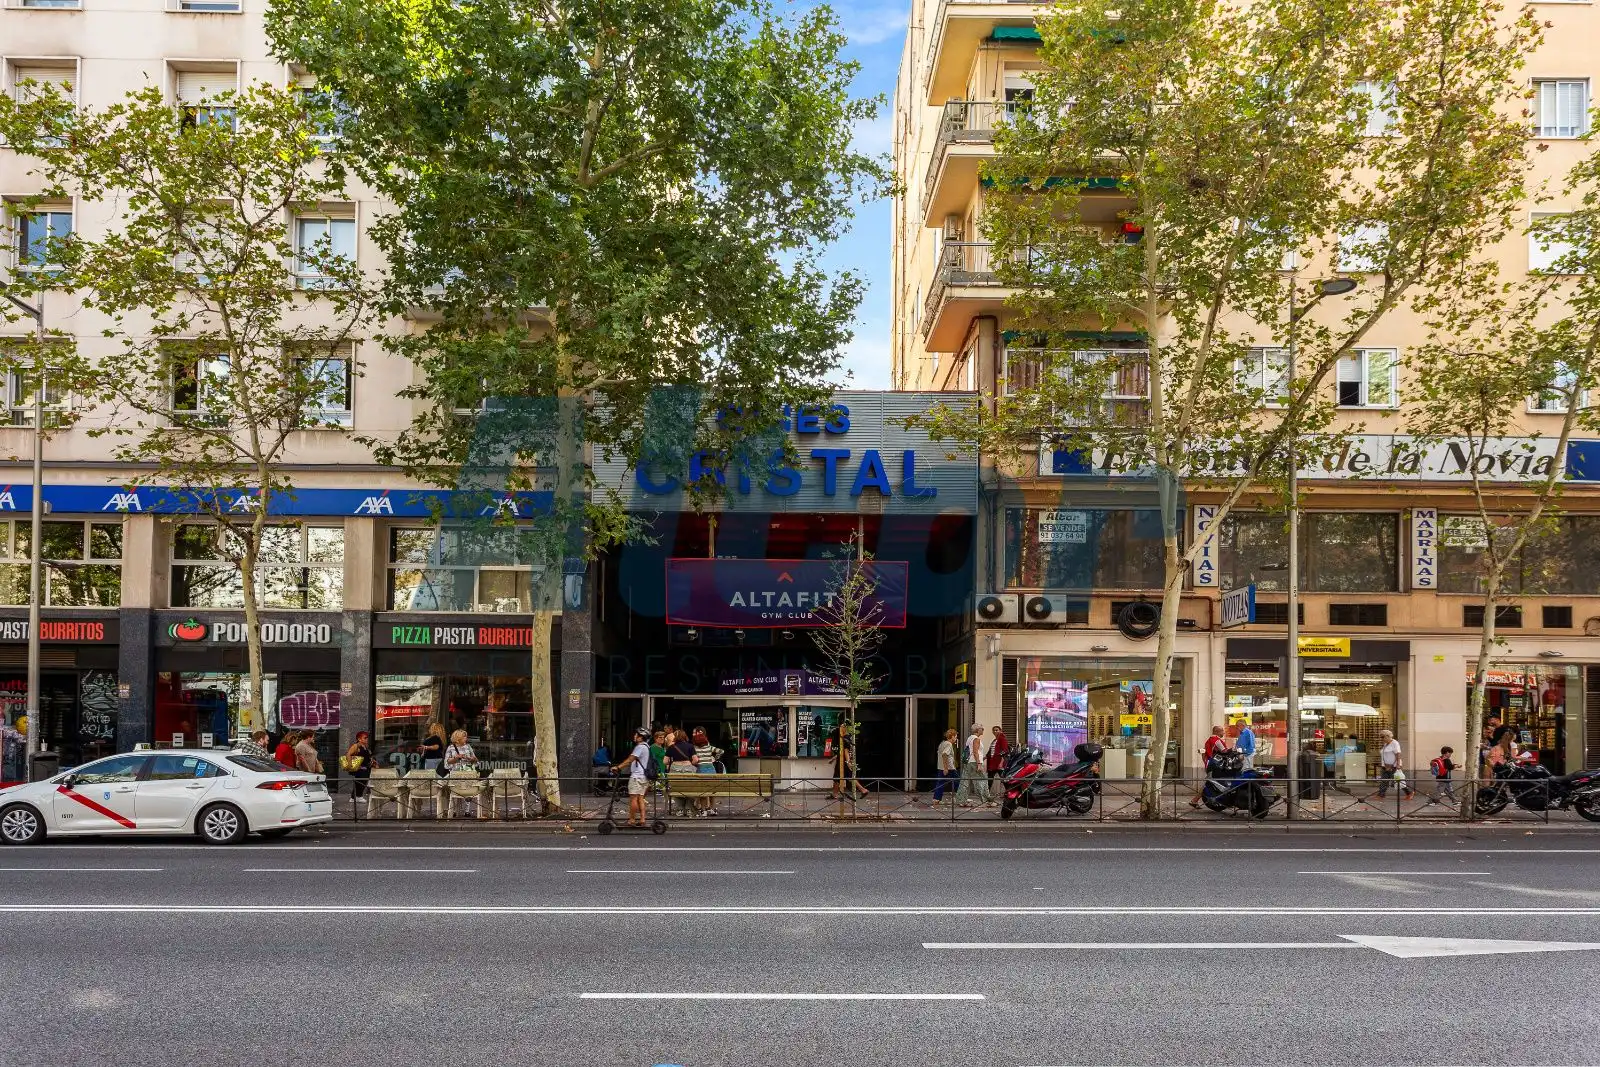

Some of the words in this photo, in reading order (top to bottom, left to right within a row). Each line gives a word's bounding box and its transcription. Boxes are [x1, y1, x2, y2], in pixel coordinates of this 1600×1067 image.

[1322, 440, 1371, 474] de
[1437, 441, 1556, 476] Novia
[636, 448, 937, 496] CRISTAL
[102, 492, 142, 511] AXA
[354, 494, 394, 514] AXA
[1055, 524, 1082, 532] VENDE
[1415, 510, 1435, 586] MADRINAS
[729, 591, 838, 608] ALTAFIT
[0, 621, 30, 640] AST
[40, 622, 104, 641] BURRITOS
[392, 626, 431, 645] PIZZA
[434, 627, 475, 646] PASTA
[478, 628, 533, 646] BURRITO
[808, 676, 831, 684] ALTAFIT
